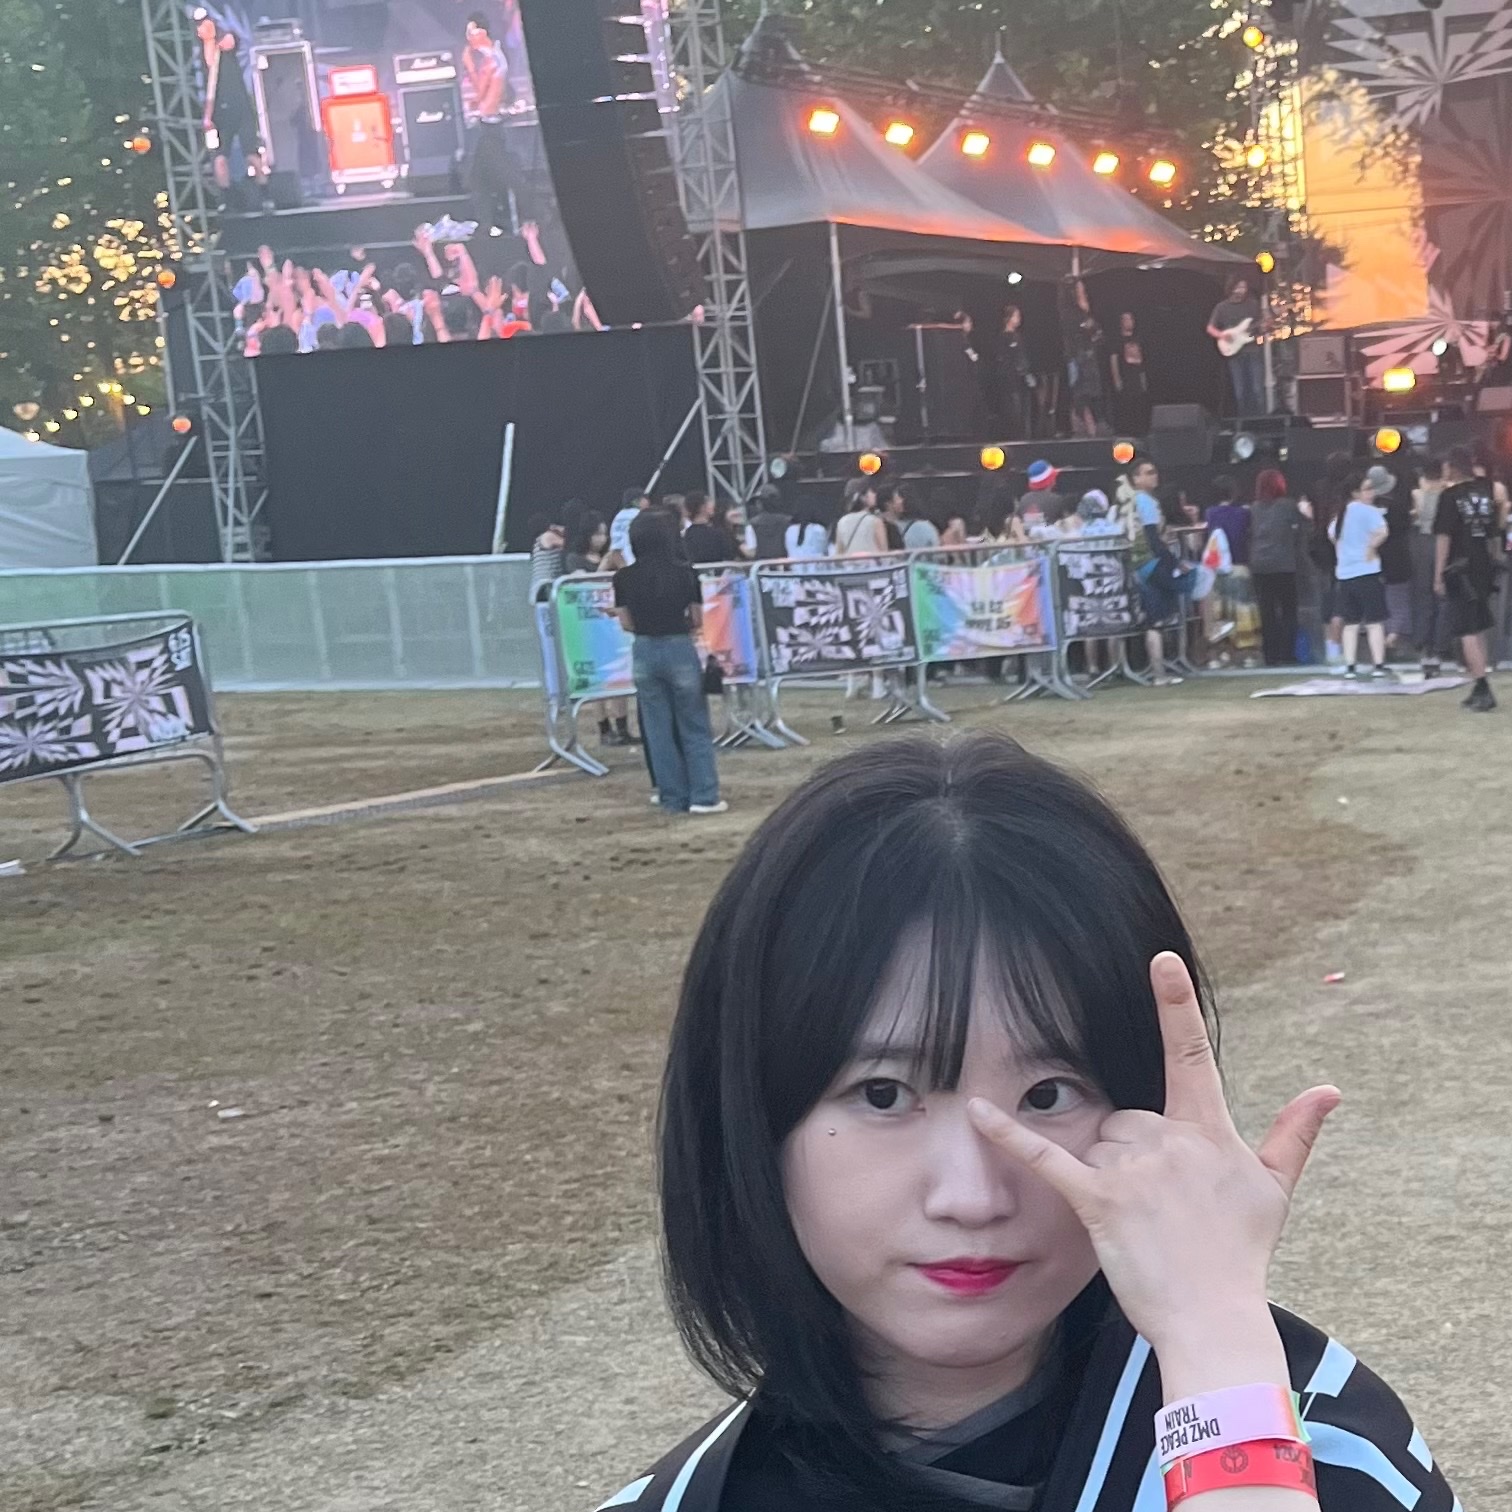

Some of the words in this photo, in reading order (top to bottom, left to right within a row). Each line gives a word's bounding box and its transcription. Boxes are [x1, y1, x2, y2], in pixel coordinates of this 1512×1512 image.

[1164, 1404, 1200, 1432] TRAIN
[1189, 1418, 1221, 1443] DMZ
[1160, 1427, 1189, 1456] PEACE
